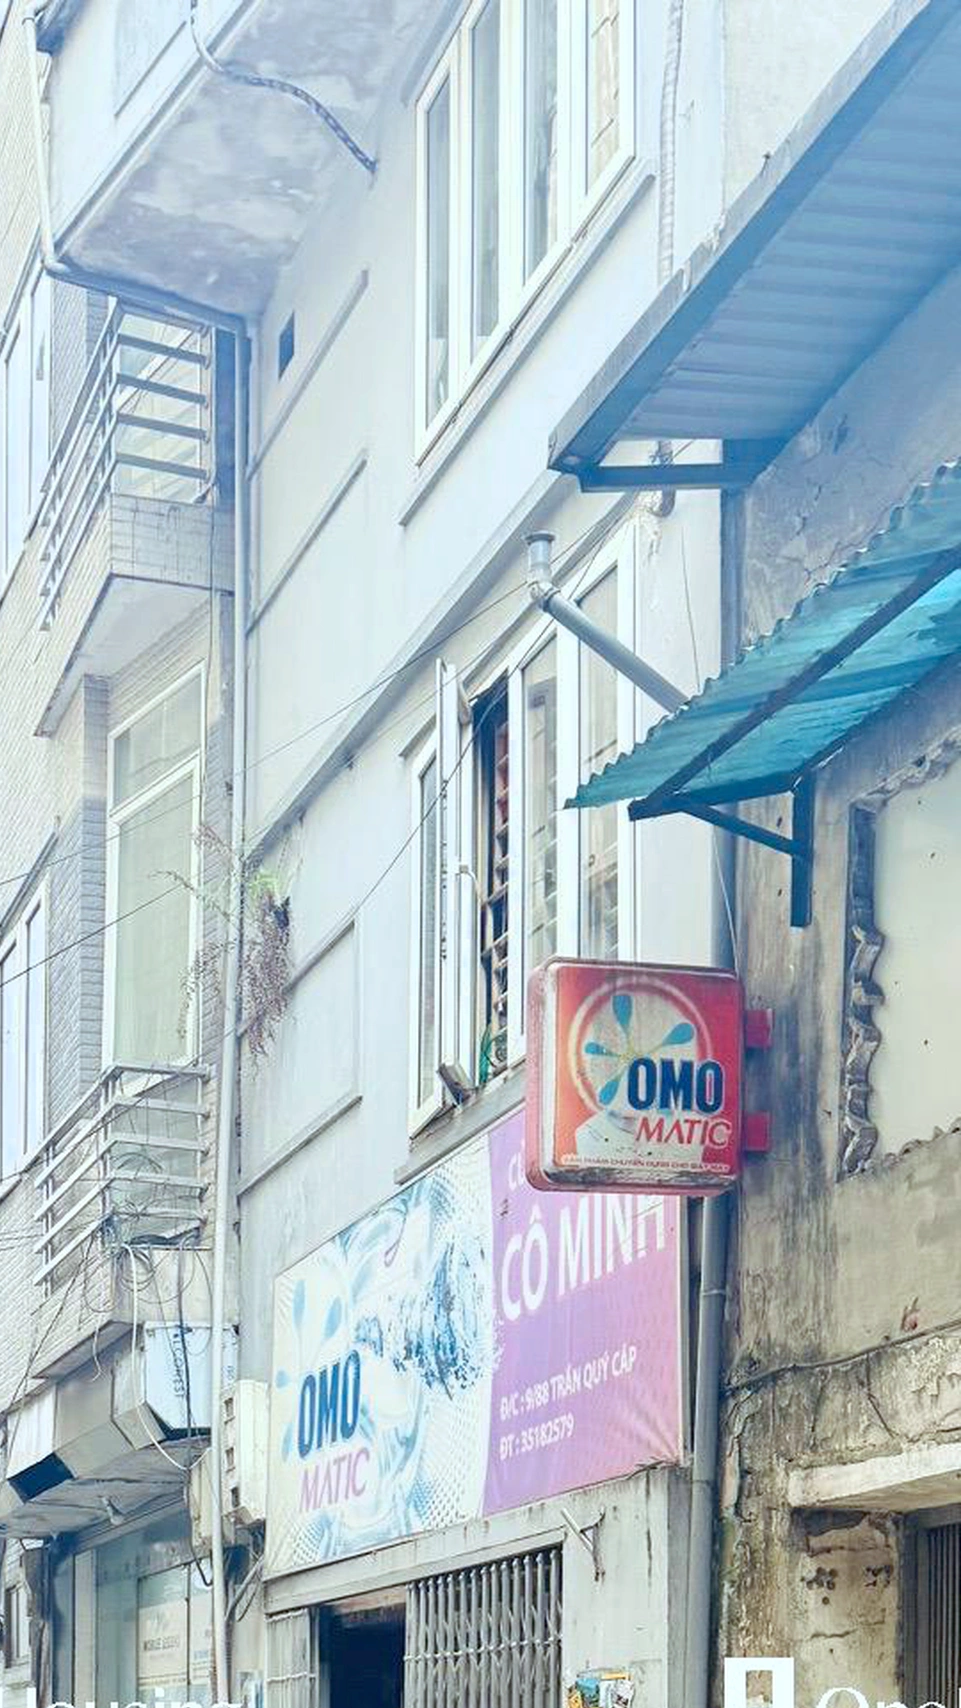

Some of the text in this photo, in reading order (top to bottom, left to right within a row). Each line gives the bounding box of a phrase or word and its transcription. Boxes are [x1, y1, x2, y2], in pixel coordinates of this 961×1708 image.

[628, 1057, 723, 1115] OMO
[635, 1117, 732, 1148] MATIC
[502, 1193, 665, 1321] CÔ MINH
[298, 1350, 360, 1458] OMO
[299, 1447, 370, 1512] MATIC
